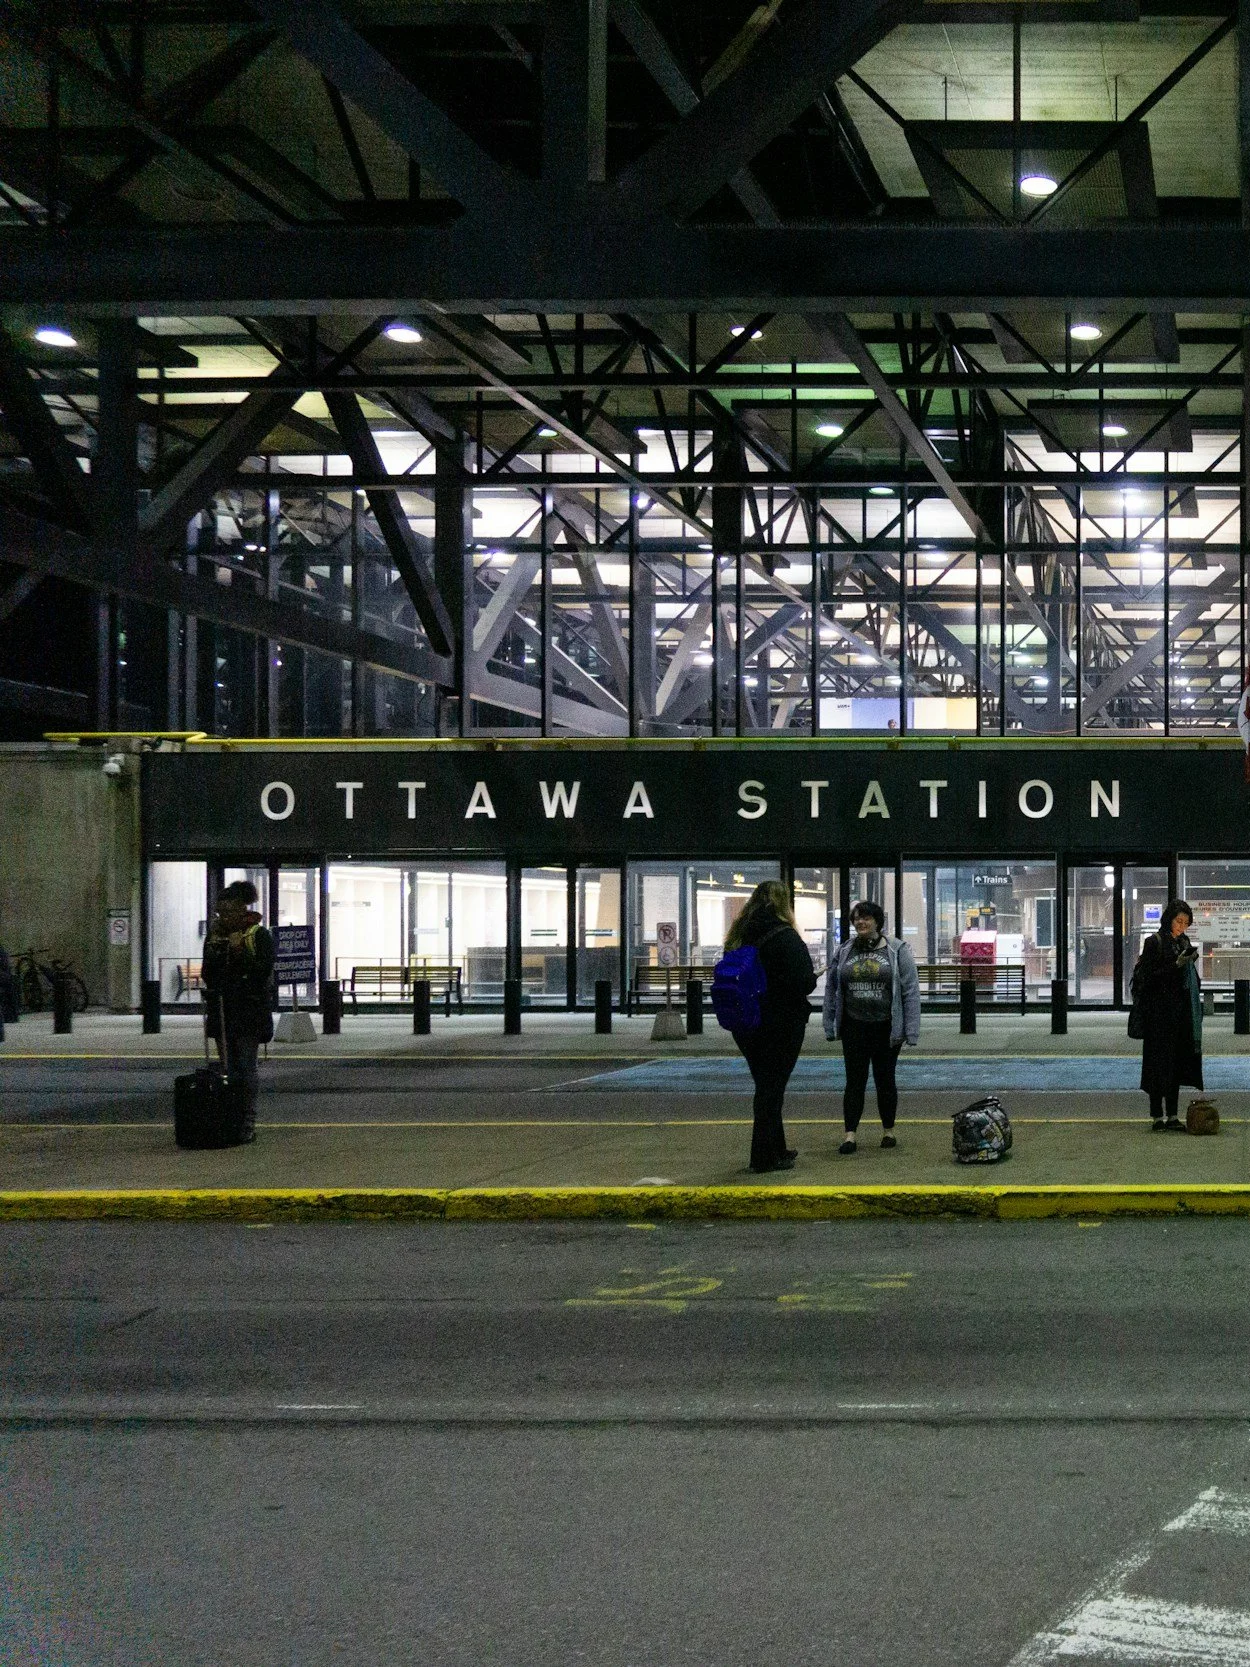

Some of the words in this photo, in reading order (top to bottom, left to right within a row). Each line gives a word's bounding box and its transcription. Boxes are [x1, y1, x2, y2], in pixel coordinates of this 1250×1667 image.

[261, 781, 655, 820] OTTAWA
[737, 779, 1120, 820] STATION
[982, 875, 1008, 884] Trains
[279, 931, 295, 940] DROP
[295, 930, 308, 939] OFF
